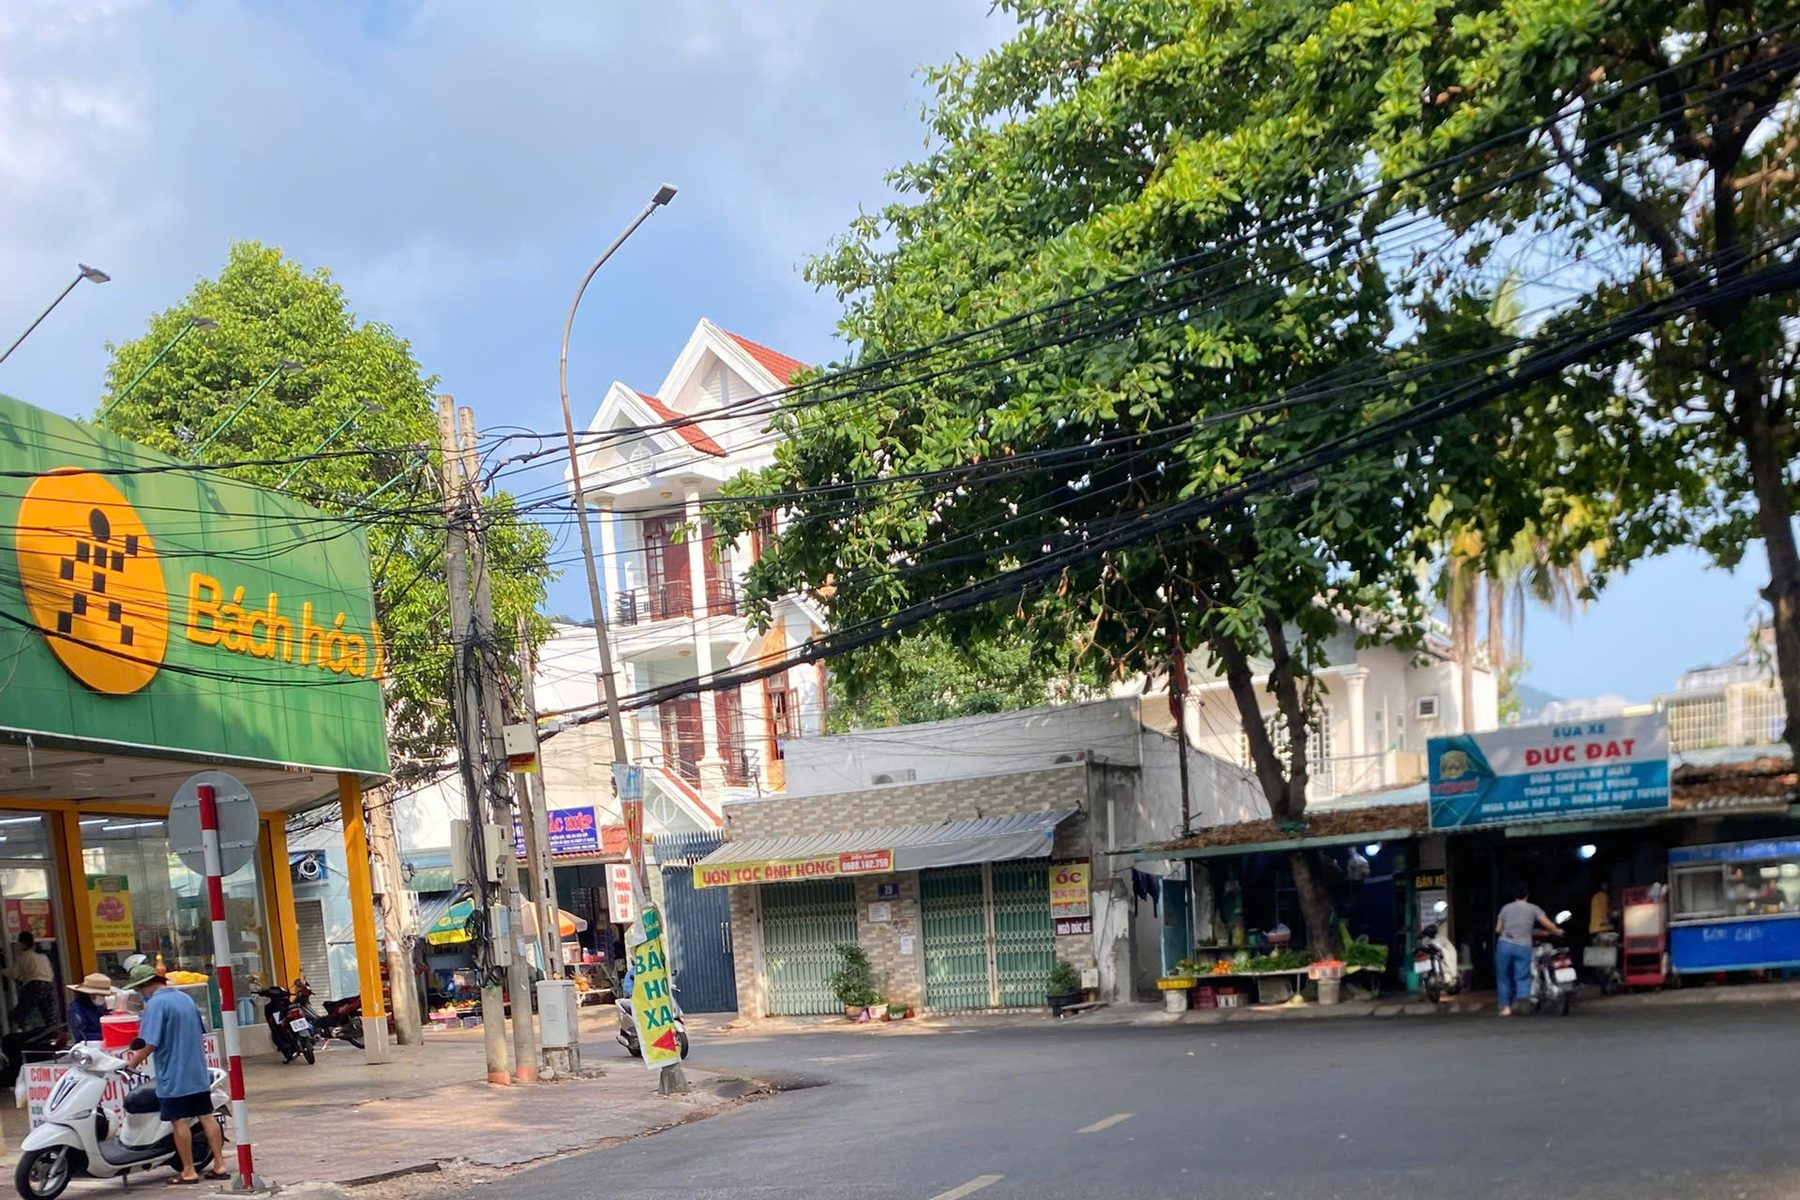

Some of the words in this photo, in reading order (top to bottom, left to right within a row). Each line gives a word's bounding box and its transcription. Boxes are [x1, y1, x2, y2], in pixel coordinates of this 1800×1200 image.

[187, 572, 293, 664] Bách
[301, 601, 367, 679] hóa
[1588, 722, 1606, 735] XE
[643, 1004, 673, 1030] XA
